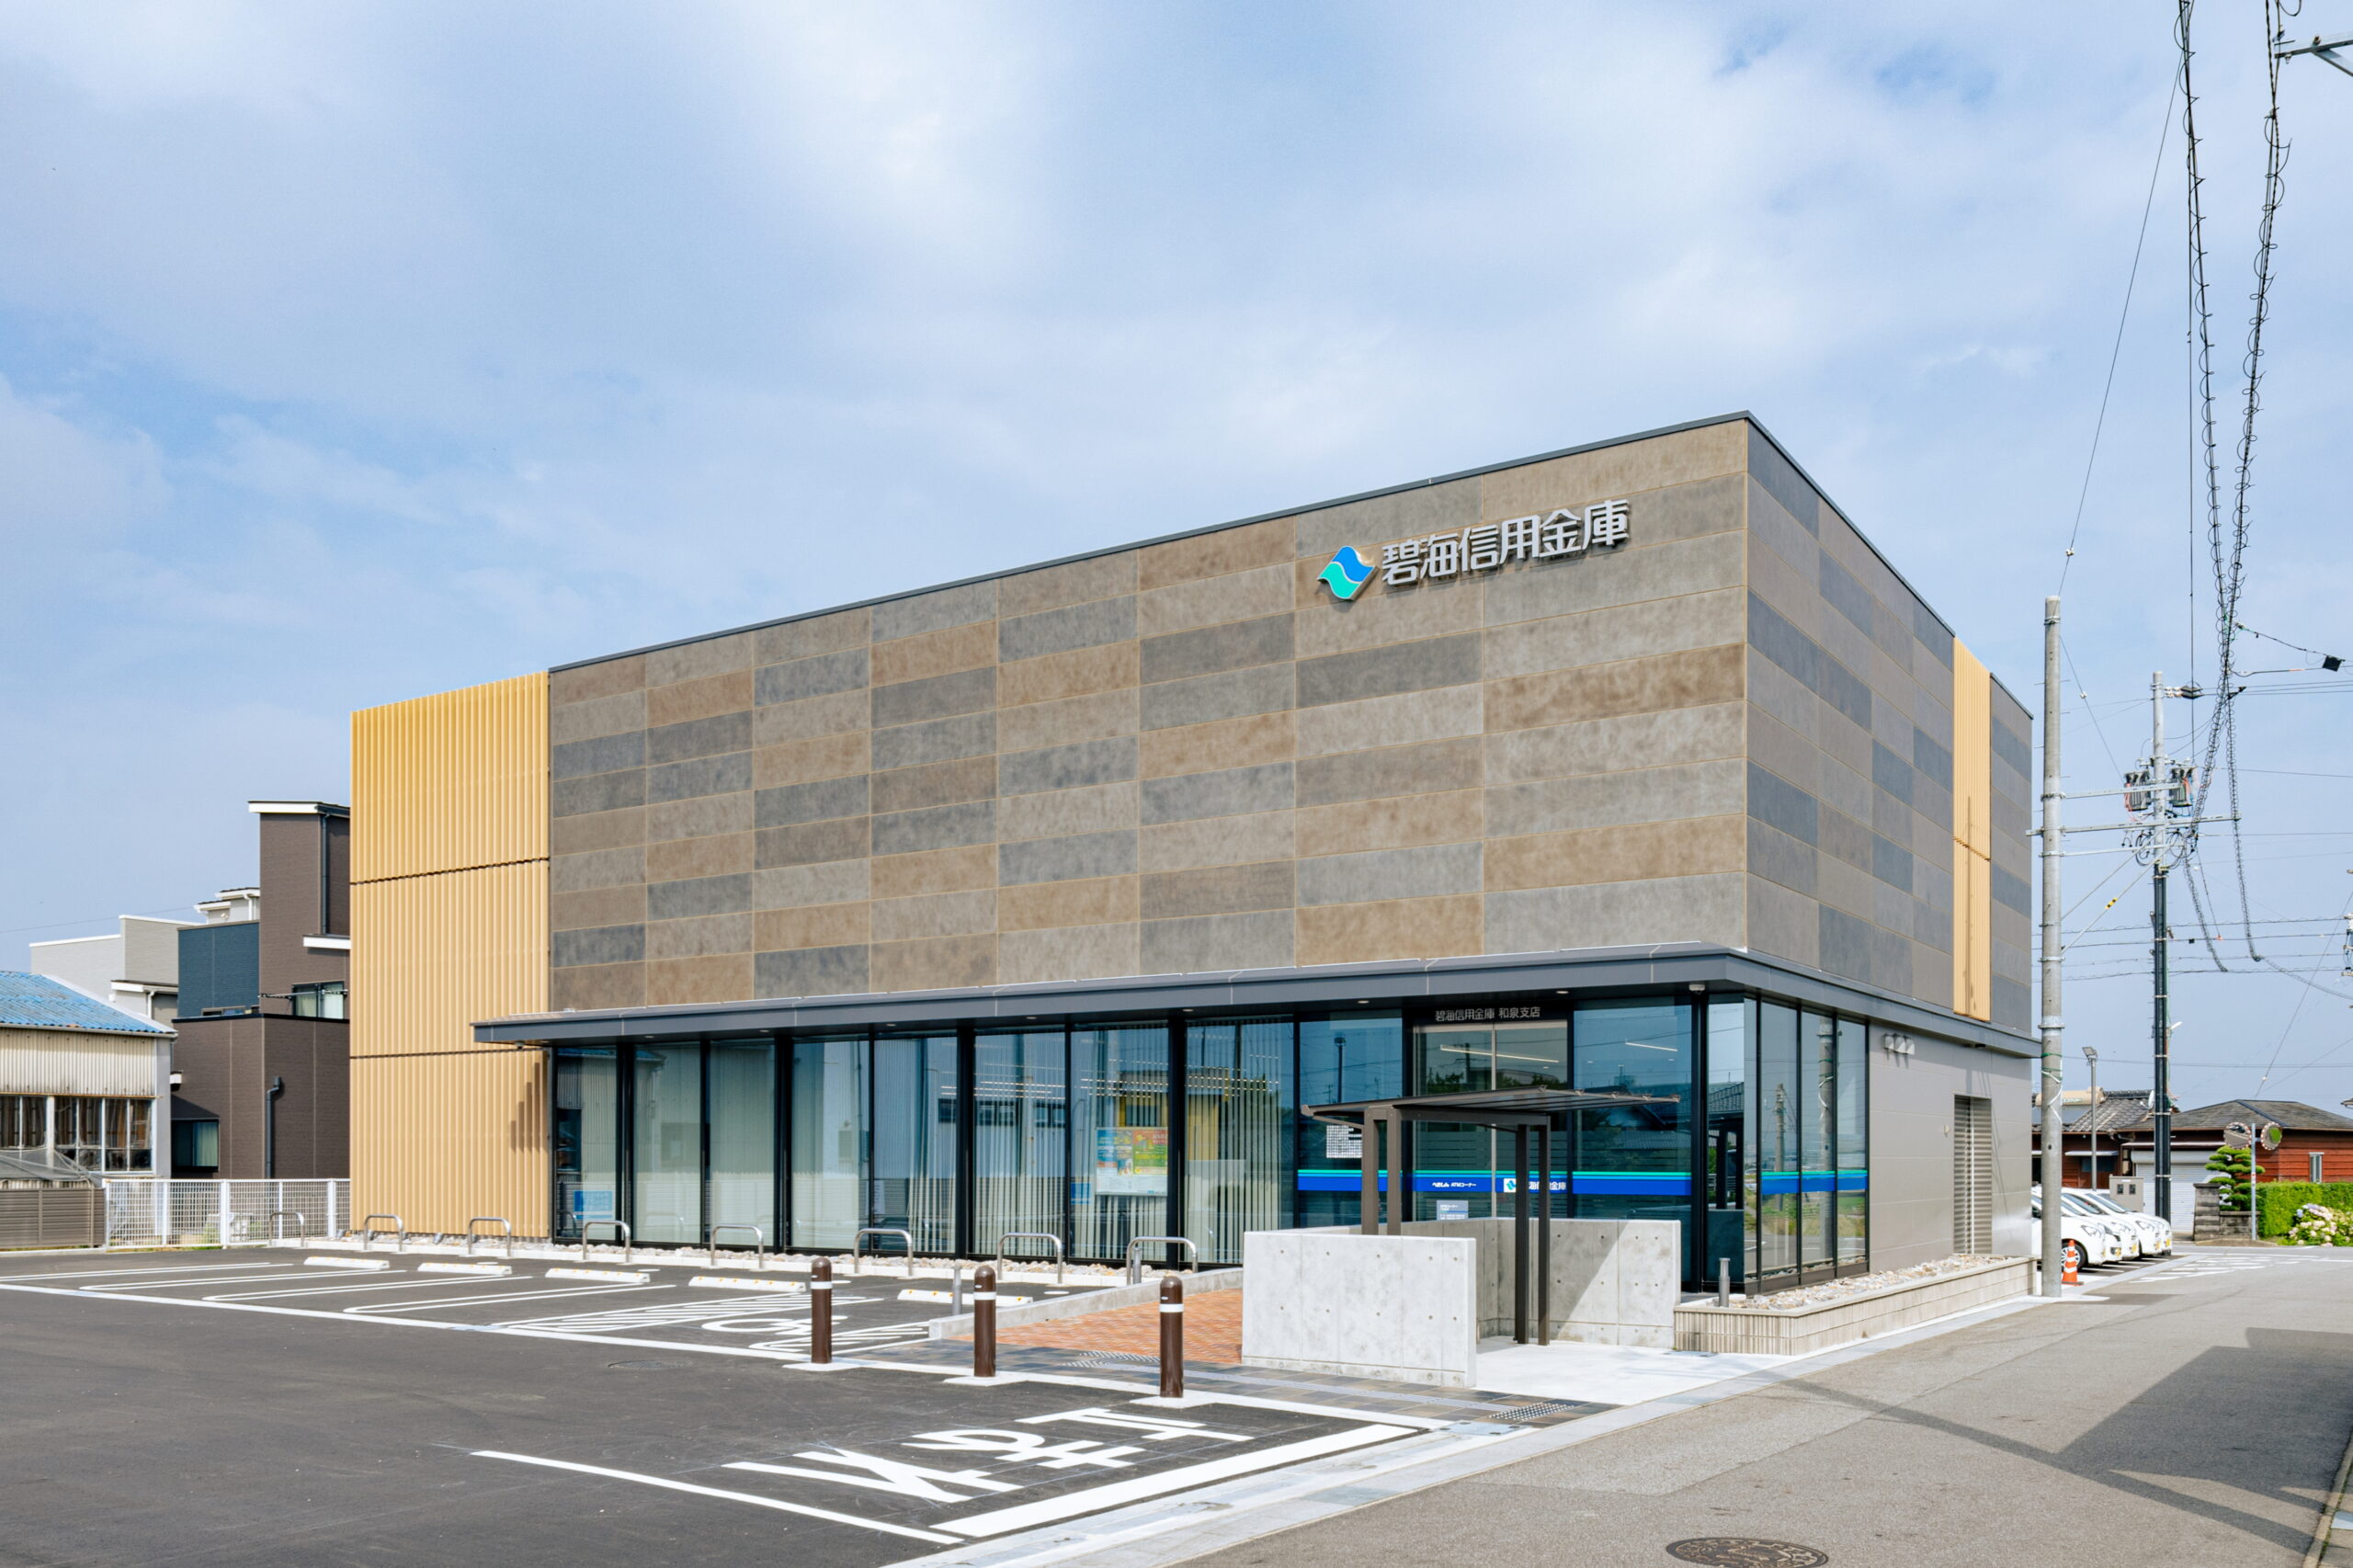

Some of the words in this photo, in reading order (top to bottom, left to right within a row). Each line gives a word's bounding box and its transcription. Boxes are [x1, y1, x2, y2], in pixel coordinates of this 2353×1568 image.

[1381, 498, 1631, 587] 碧海信用金庫
[1435, 1008, 1495, 1022] 碧海信用金庫
[1498, 1006, 1540, 1018] 和泉支店
[721, 1408, 1254, 1503] 止まれ
